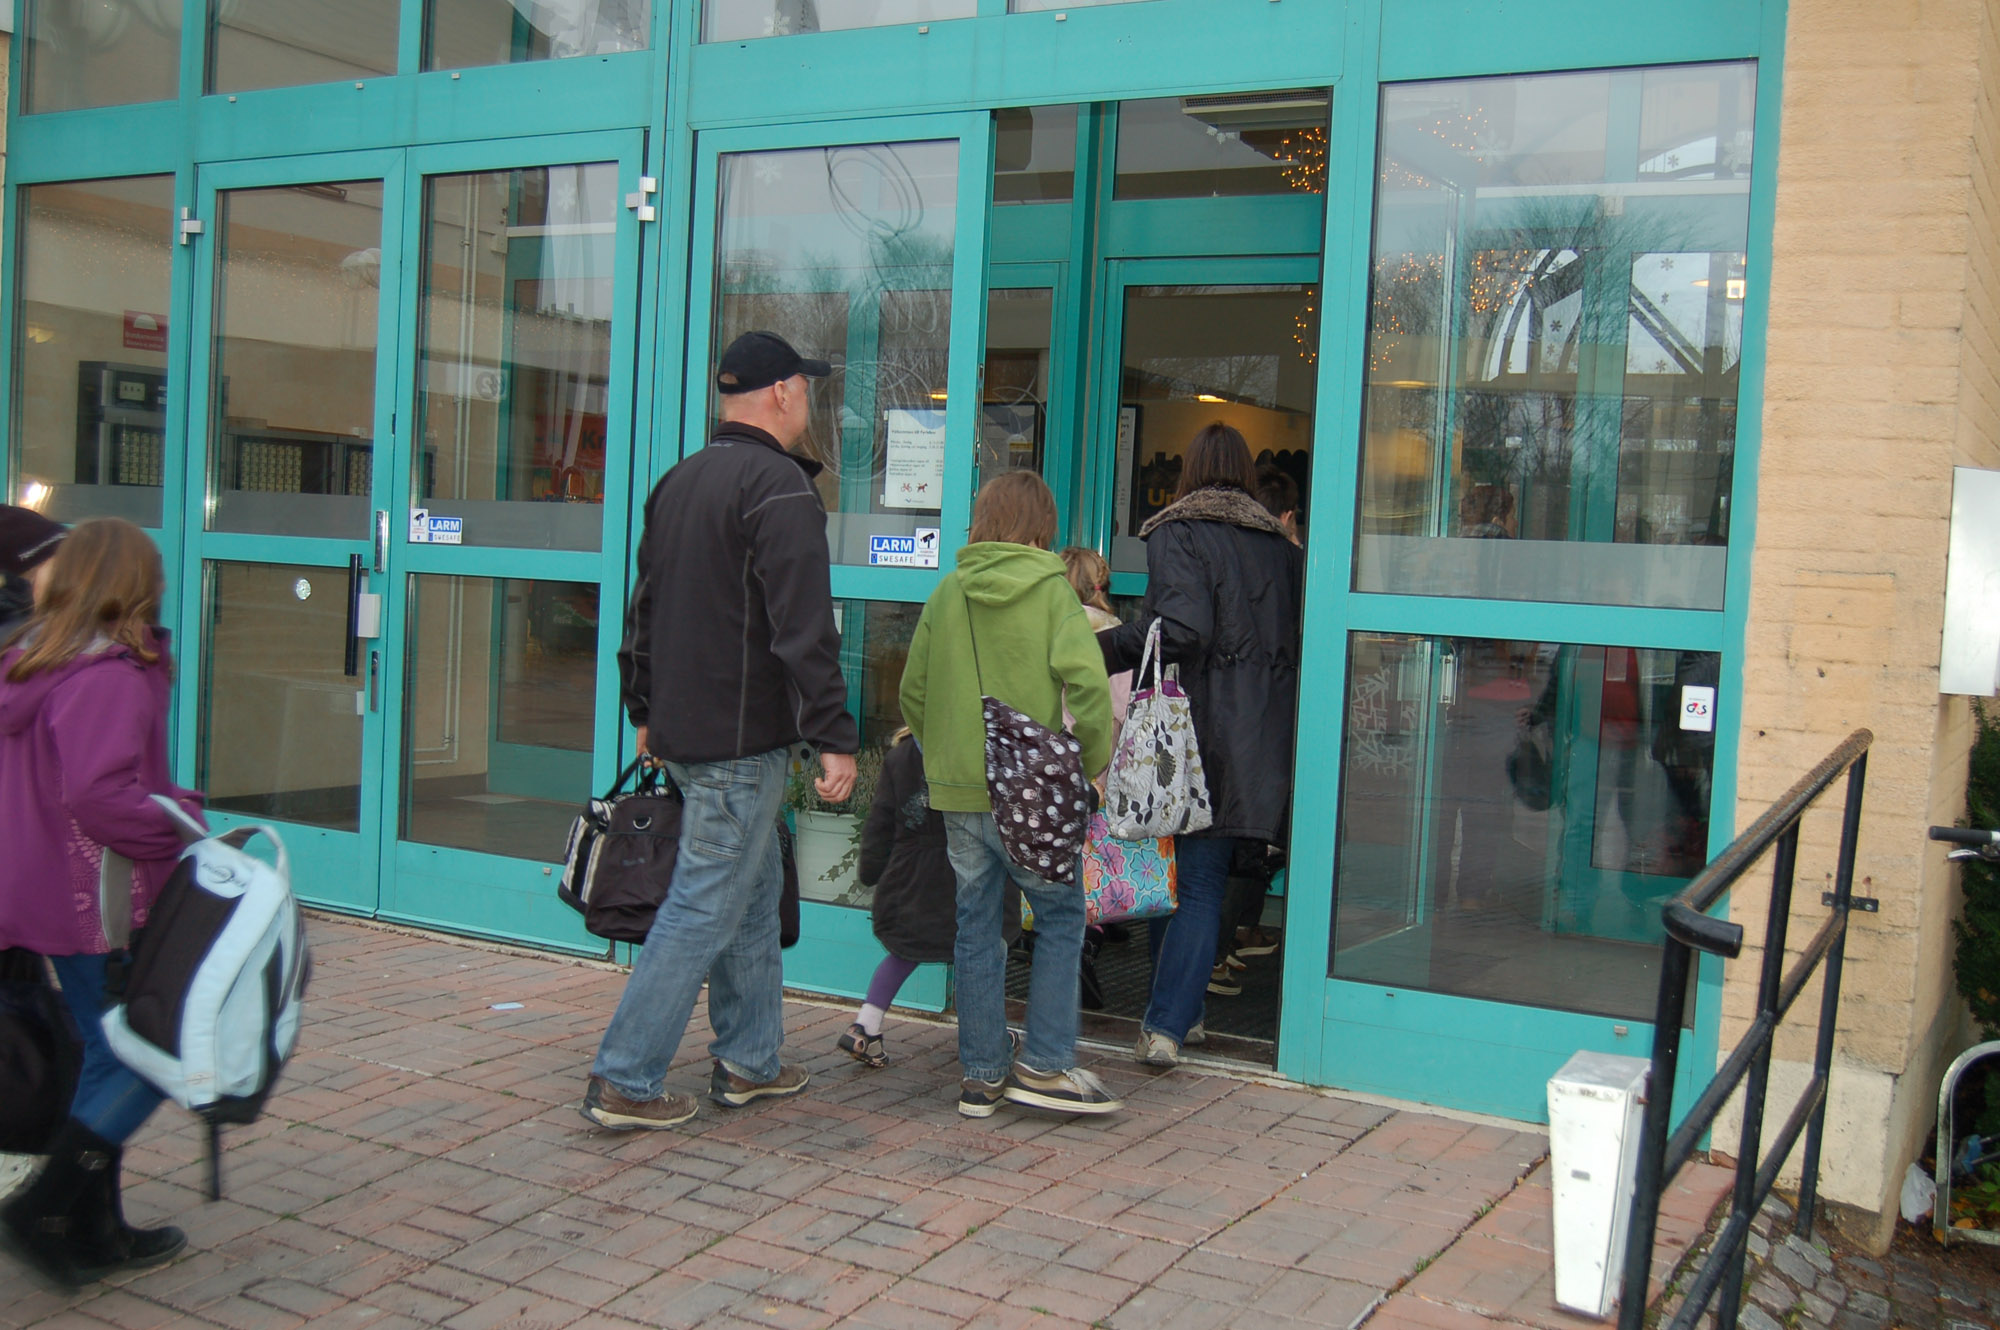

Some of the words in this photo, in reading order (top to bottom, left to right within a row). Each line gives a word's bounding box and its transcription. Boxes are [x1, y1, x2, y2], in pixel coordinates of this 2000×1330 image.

[429, 519, 460, 532] LARM
[873, 538, 912, 552] LARM
[878, 555, 914, 564] SWESAFE
